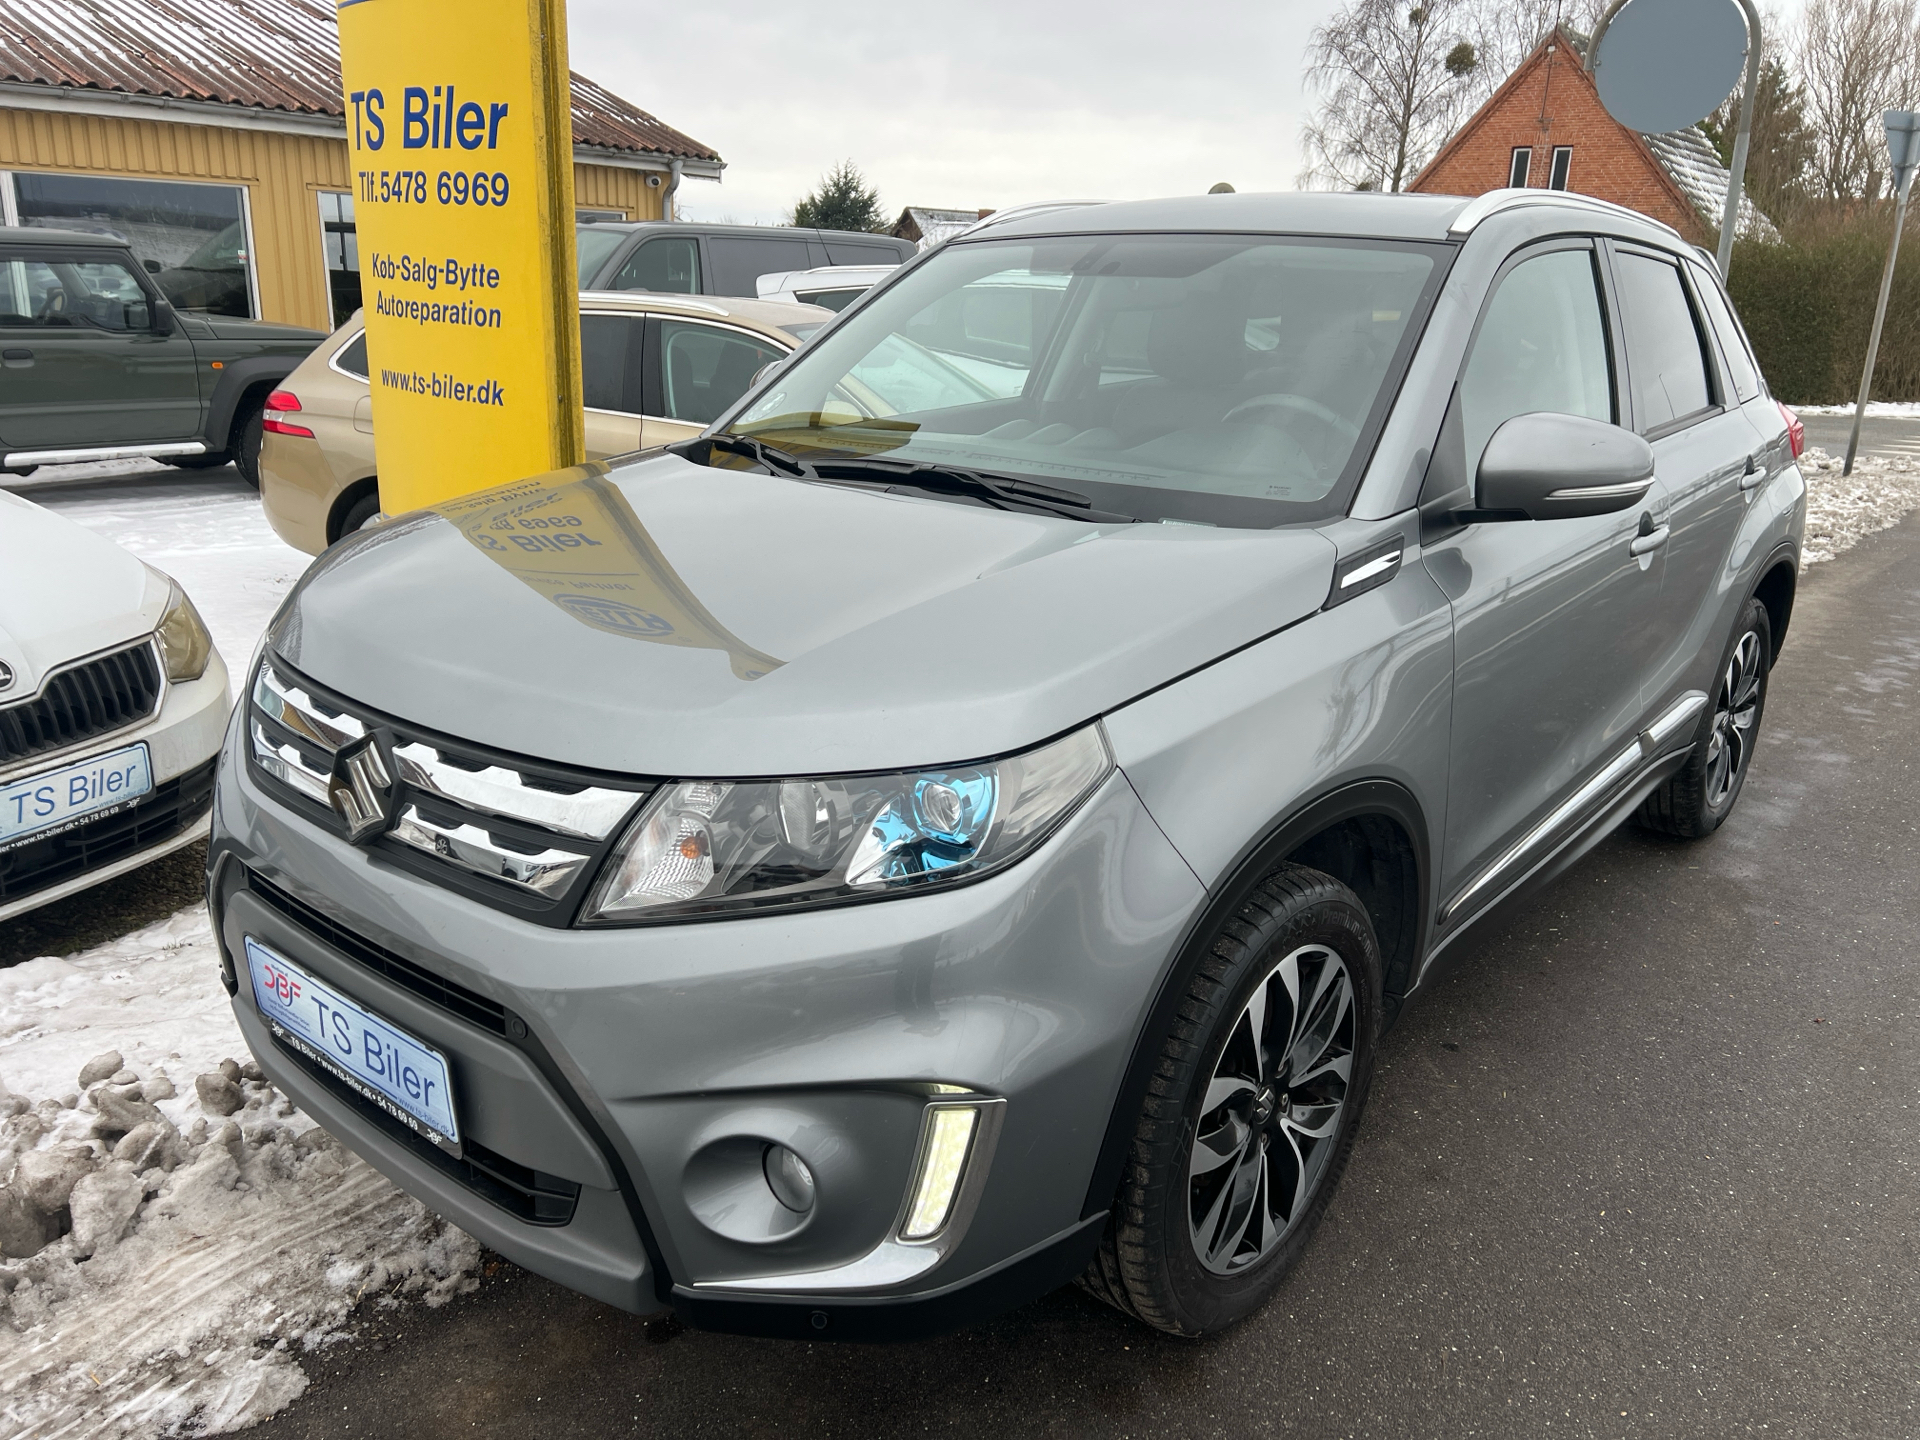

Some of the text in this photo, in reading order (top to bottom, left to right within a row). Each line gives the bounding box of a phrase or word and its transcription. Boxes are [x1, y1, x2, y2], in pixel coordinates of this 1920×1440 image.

[350, 85, 509, 151] TS Biler
[436, 170, 510, 206] 6969
[371, 252, 501, 290] Køb-Salg-Bytte
[375, 290, 502, 328] Autoreparation
[381, 368, 505, 406] www.ts-biler.dk
[9, 765, 136, 824] TS Biler
[15, 822, 75, 847] www.ts-biler.dk
[79, 816, 89, 826] 54
[90, 813, 99, 822] 78
[290, 1036, 301, 1050] TS
[311, 995, 352, 1055] TS
[363, 1029, 435, 1107] Biler
